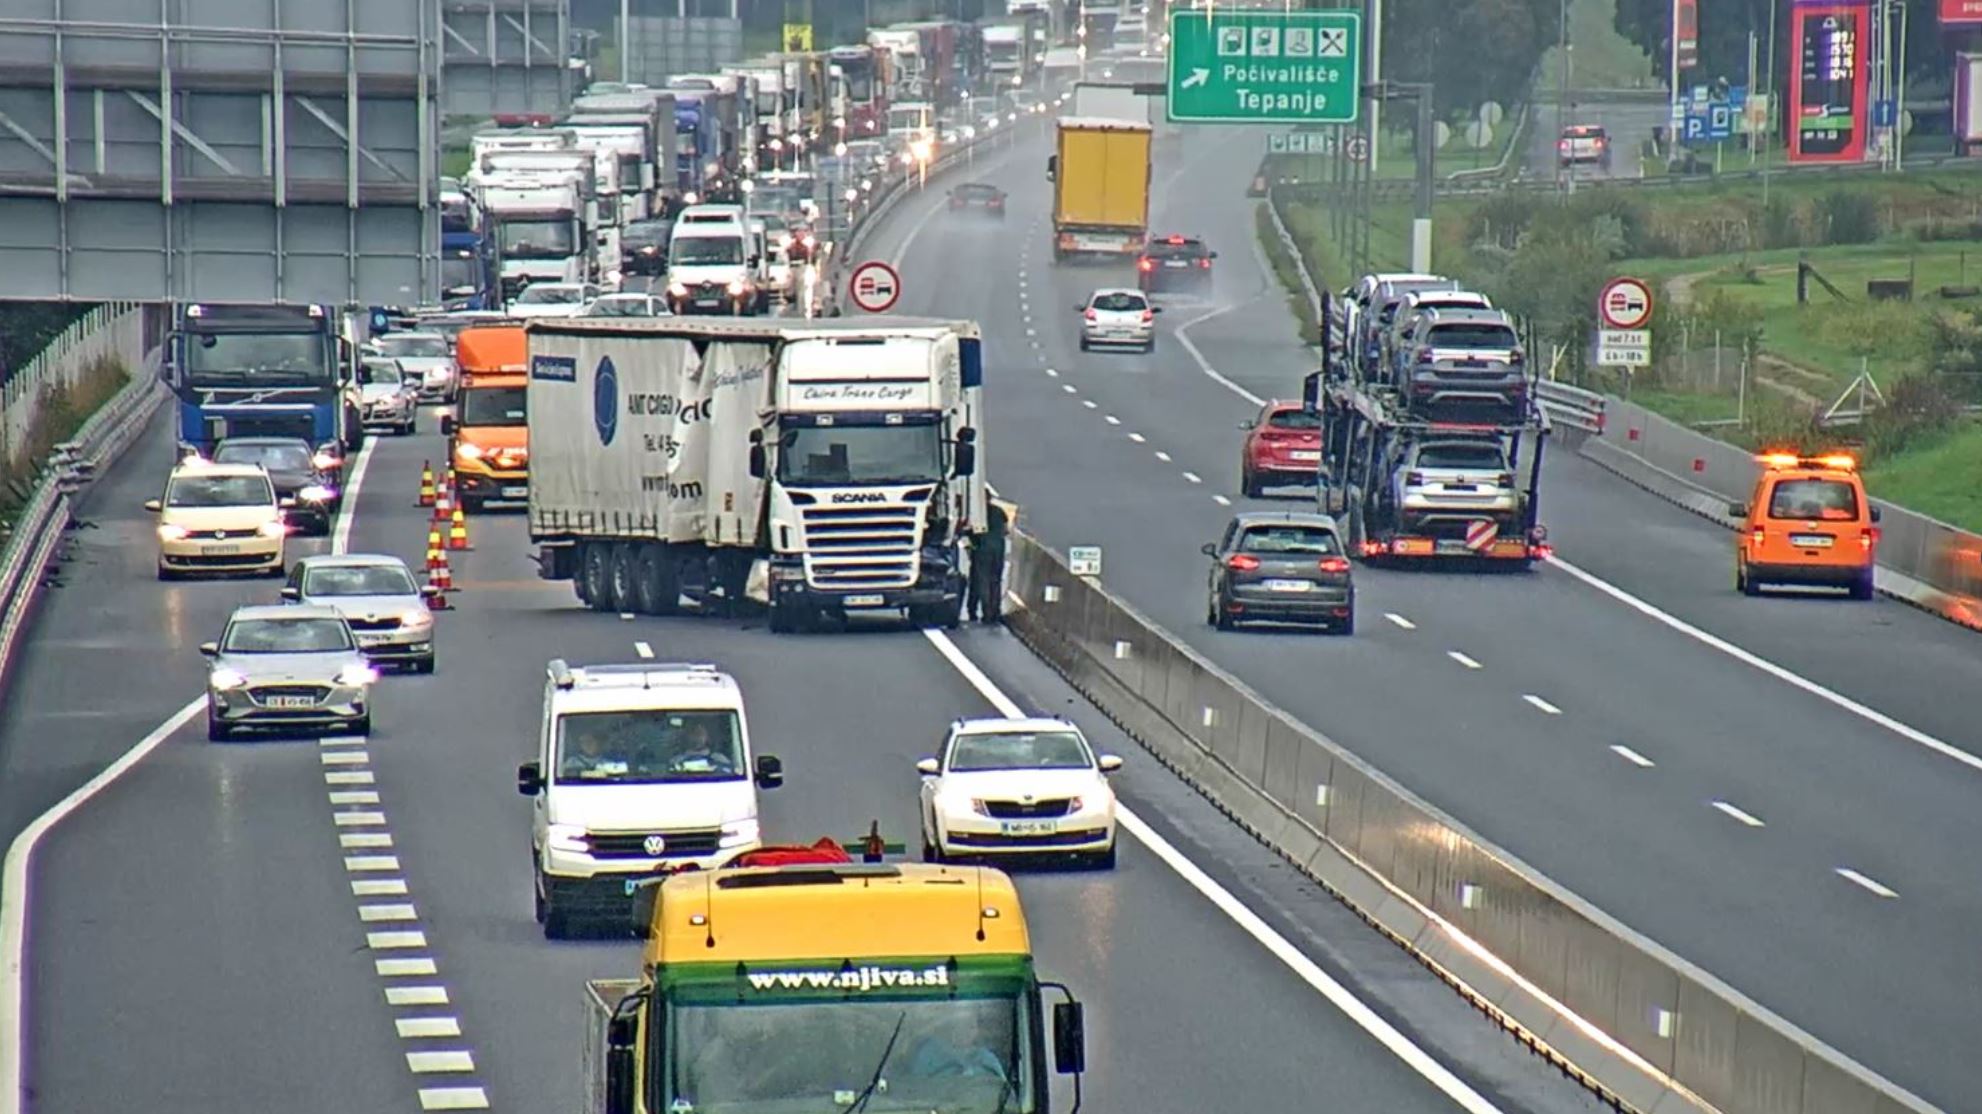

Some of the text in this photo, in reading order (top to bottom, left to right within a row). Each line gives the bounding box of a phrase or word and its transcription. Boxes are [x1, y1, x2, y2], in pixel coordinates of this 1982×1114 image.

[1223, 64, 1339, 83] Počivališče
[1236, 89, 1327, 114] Tepanje
[831, 492, 887, 504] SCANIA
[748, 965, 949, 991] www.njiva.si
